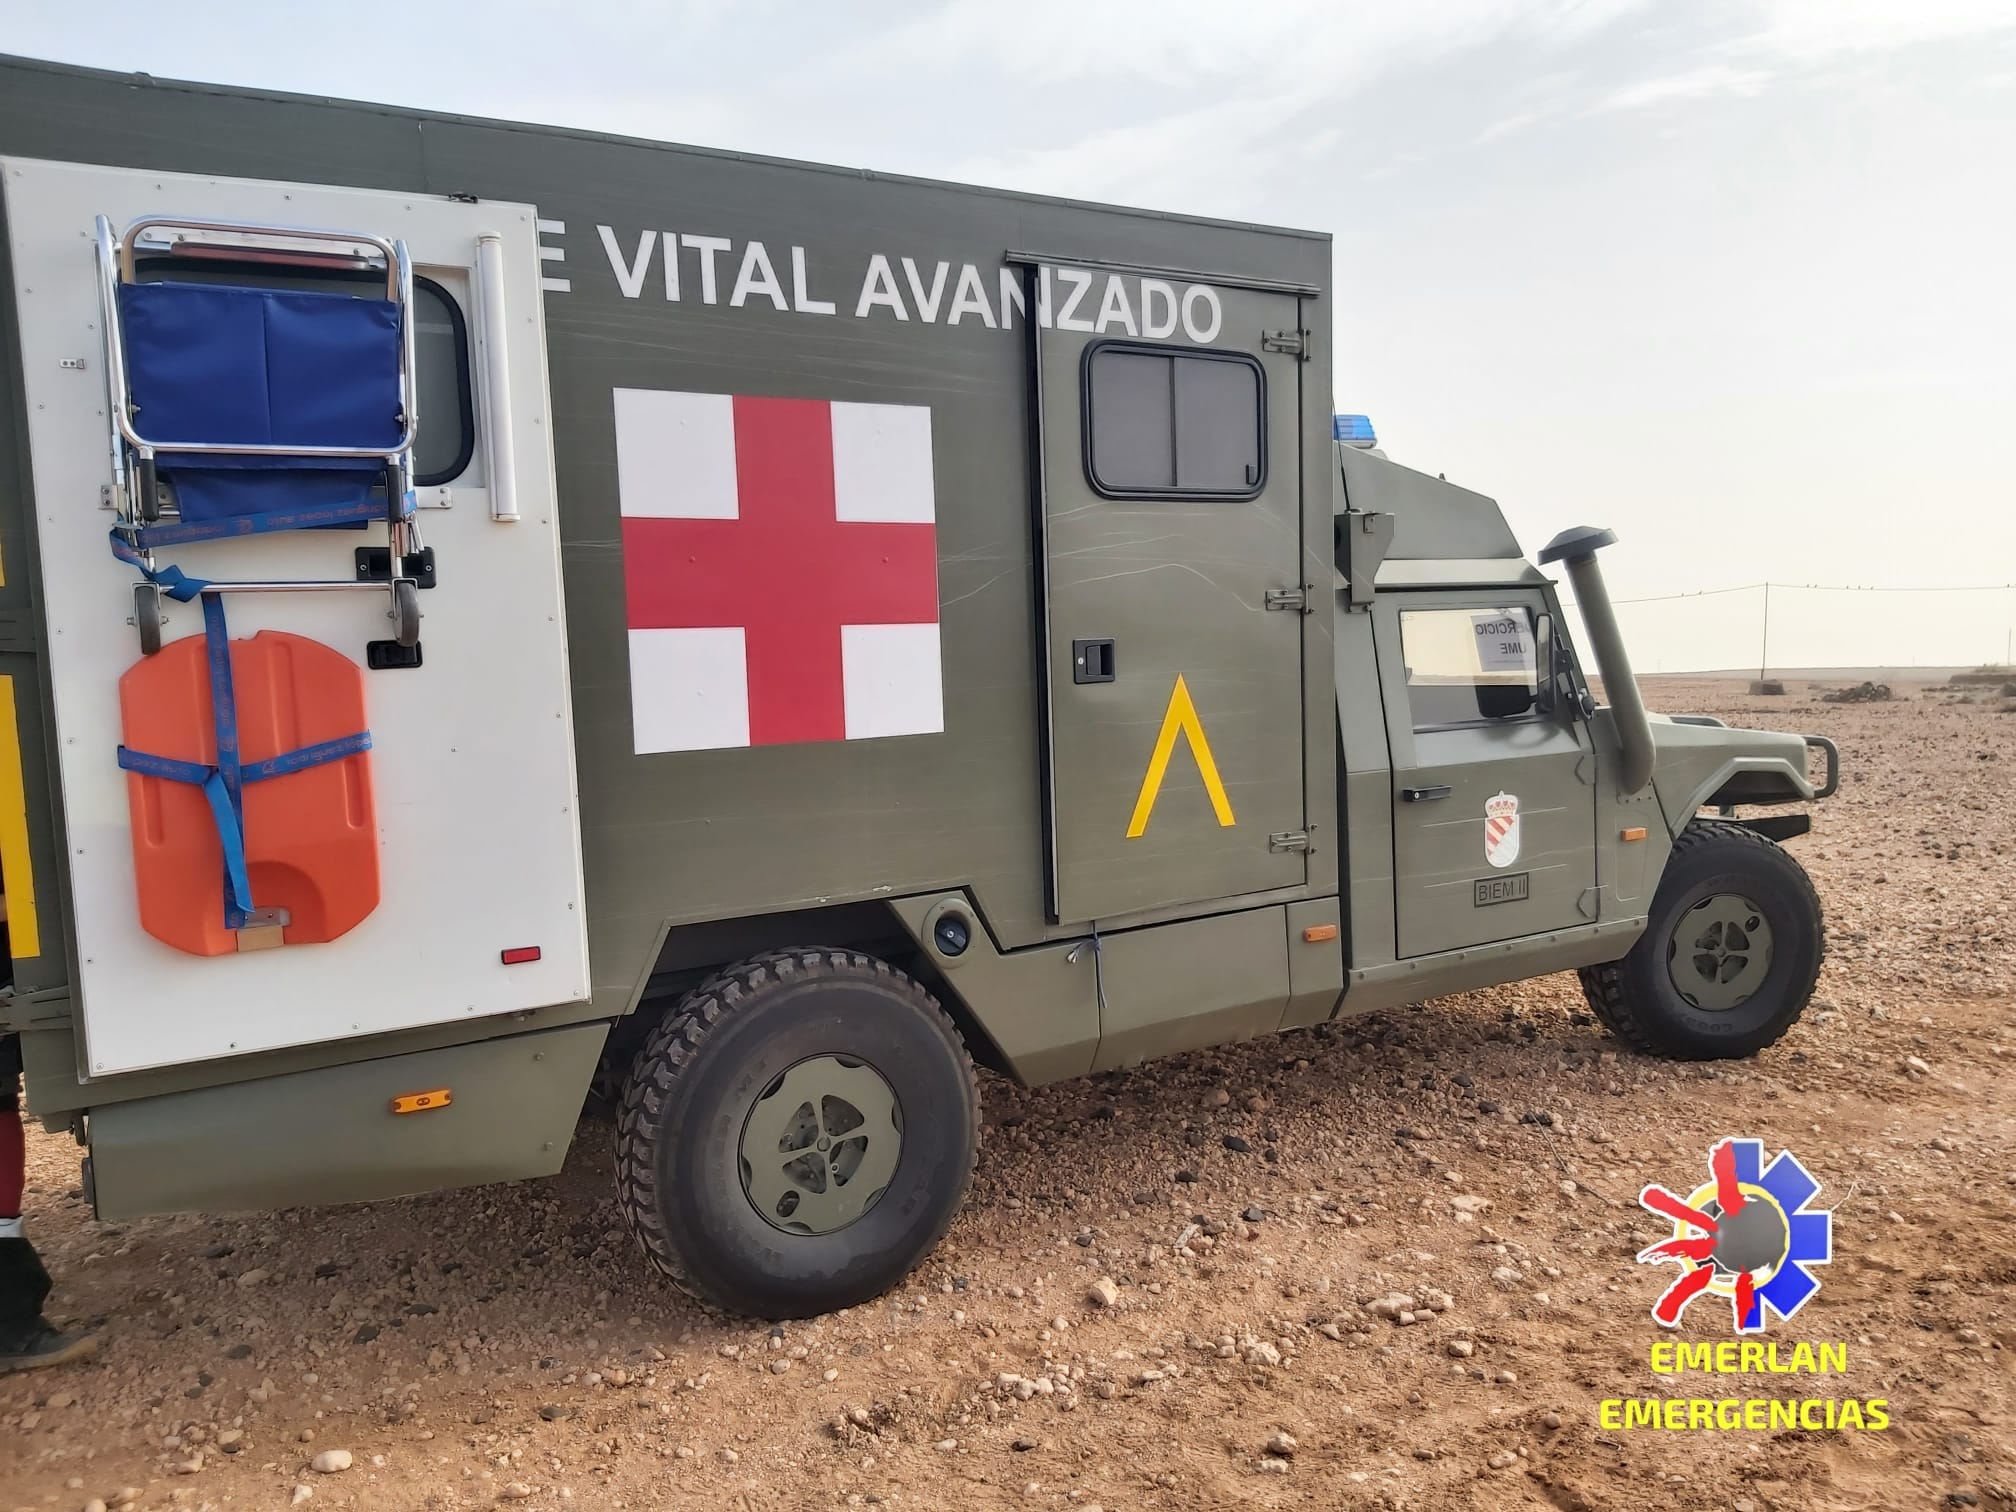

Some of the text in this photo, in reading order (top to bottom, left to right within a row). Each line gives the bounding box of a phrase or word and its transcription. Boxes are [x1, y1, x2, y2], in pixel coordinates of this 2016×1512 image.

[596, 224, 837, 316] VITAL
[854, 253, 1222, 343] AVANZADO
[1478, 880, 1514, 901] BIEM
